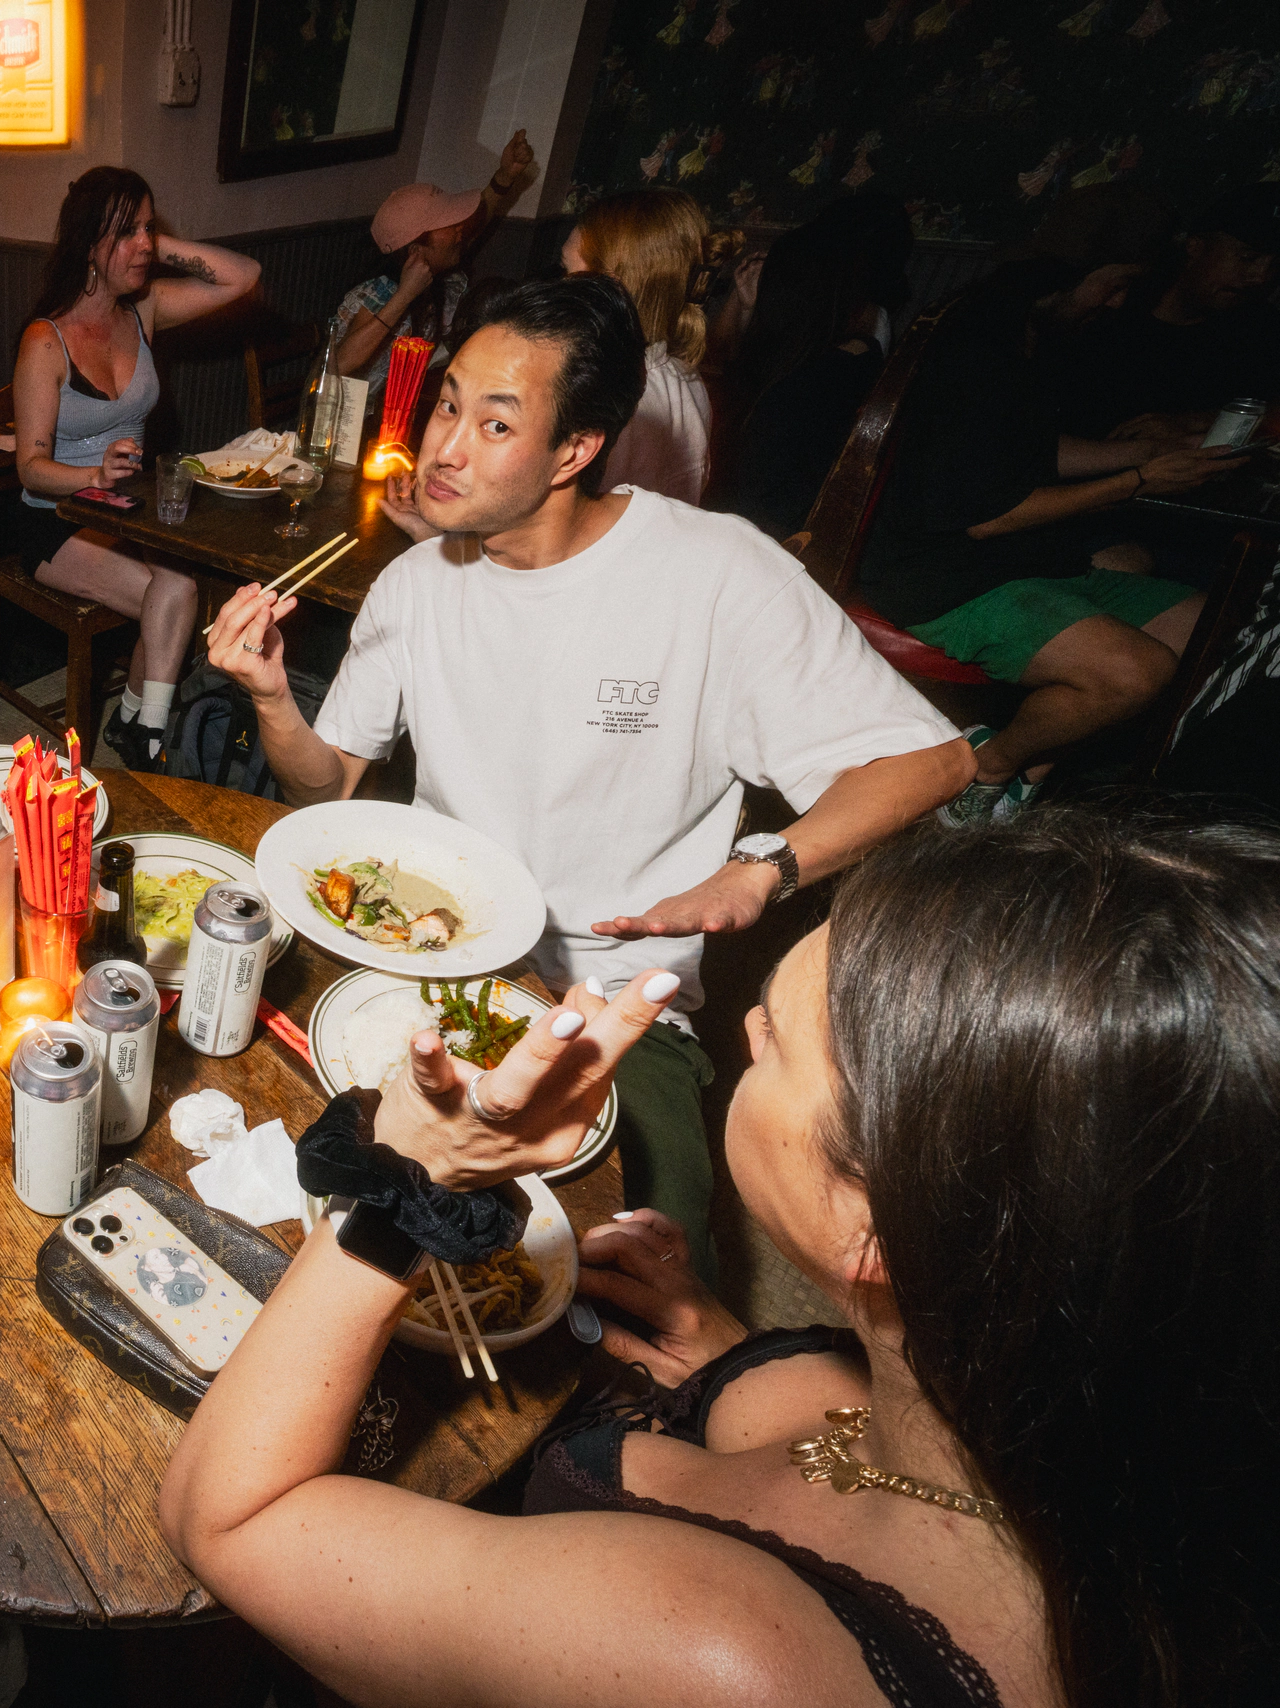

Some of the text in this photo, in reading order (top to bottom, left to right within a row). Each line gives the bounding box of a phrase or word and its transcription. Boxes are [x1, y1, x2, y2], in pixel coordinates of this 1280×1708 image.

[597, 679, 659, 705] FTC
[243, 959, 256, 985] Brewing
[126, 1048, 138, 1073] Brewing
